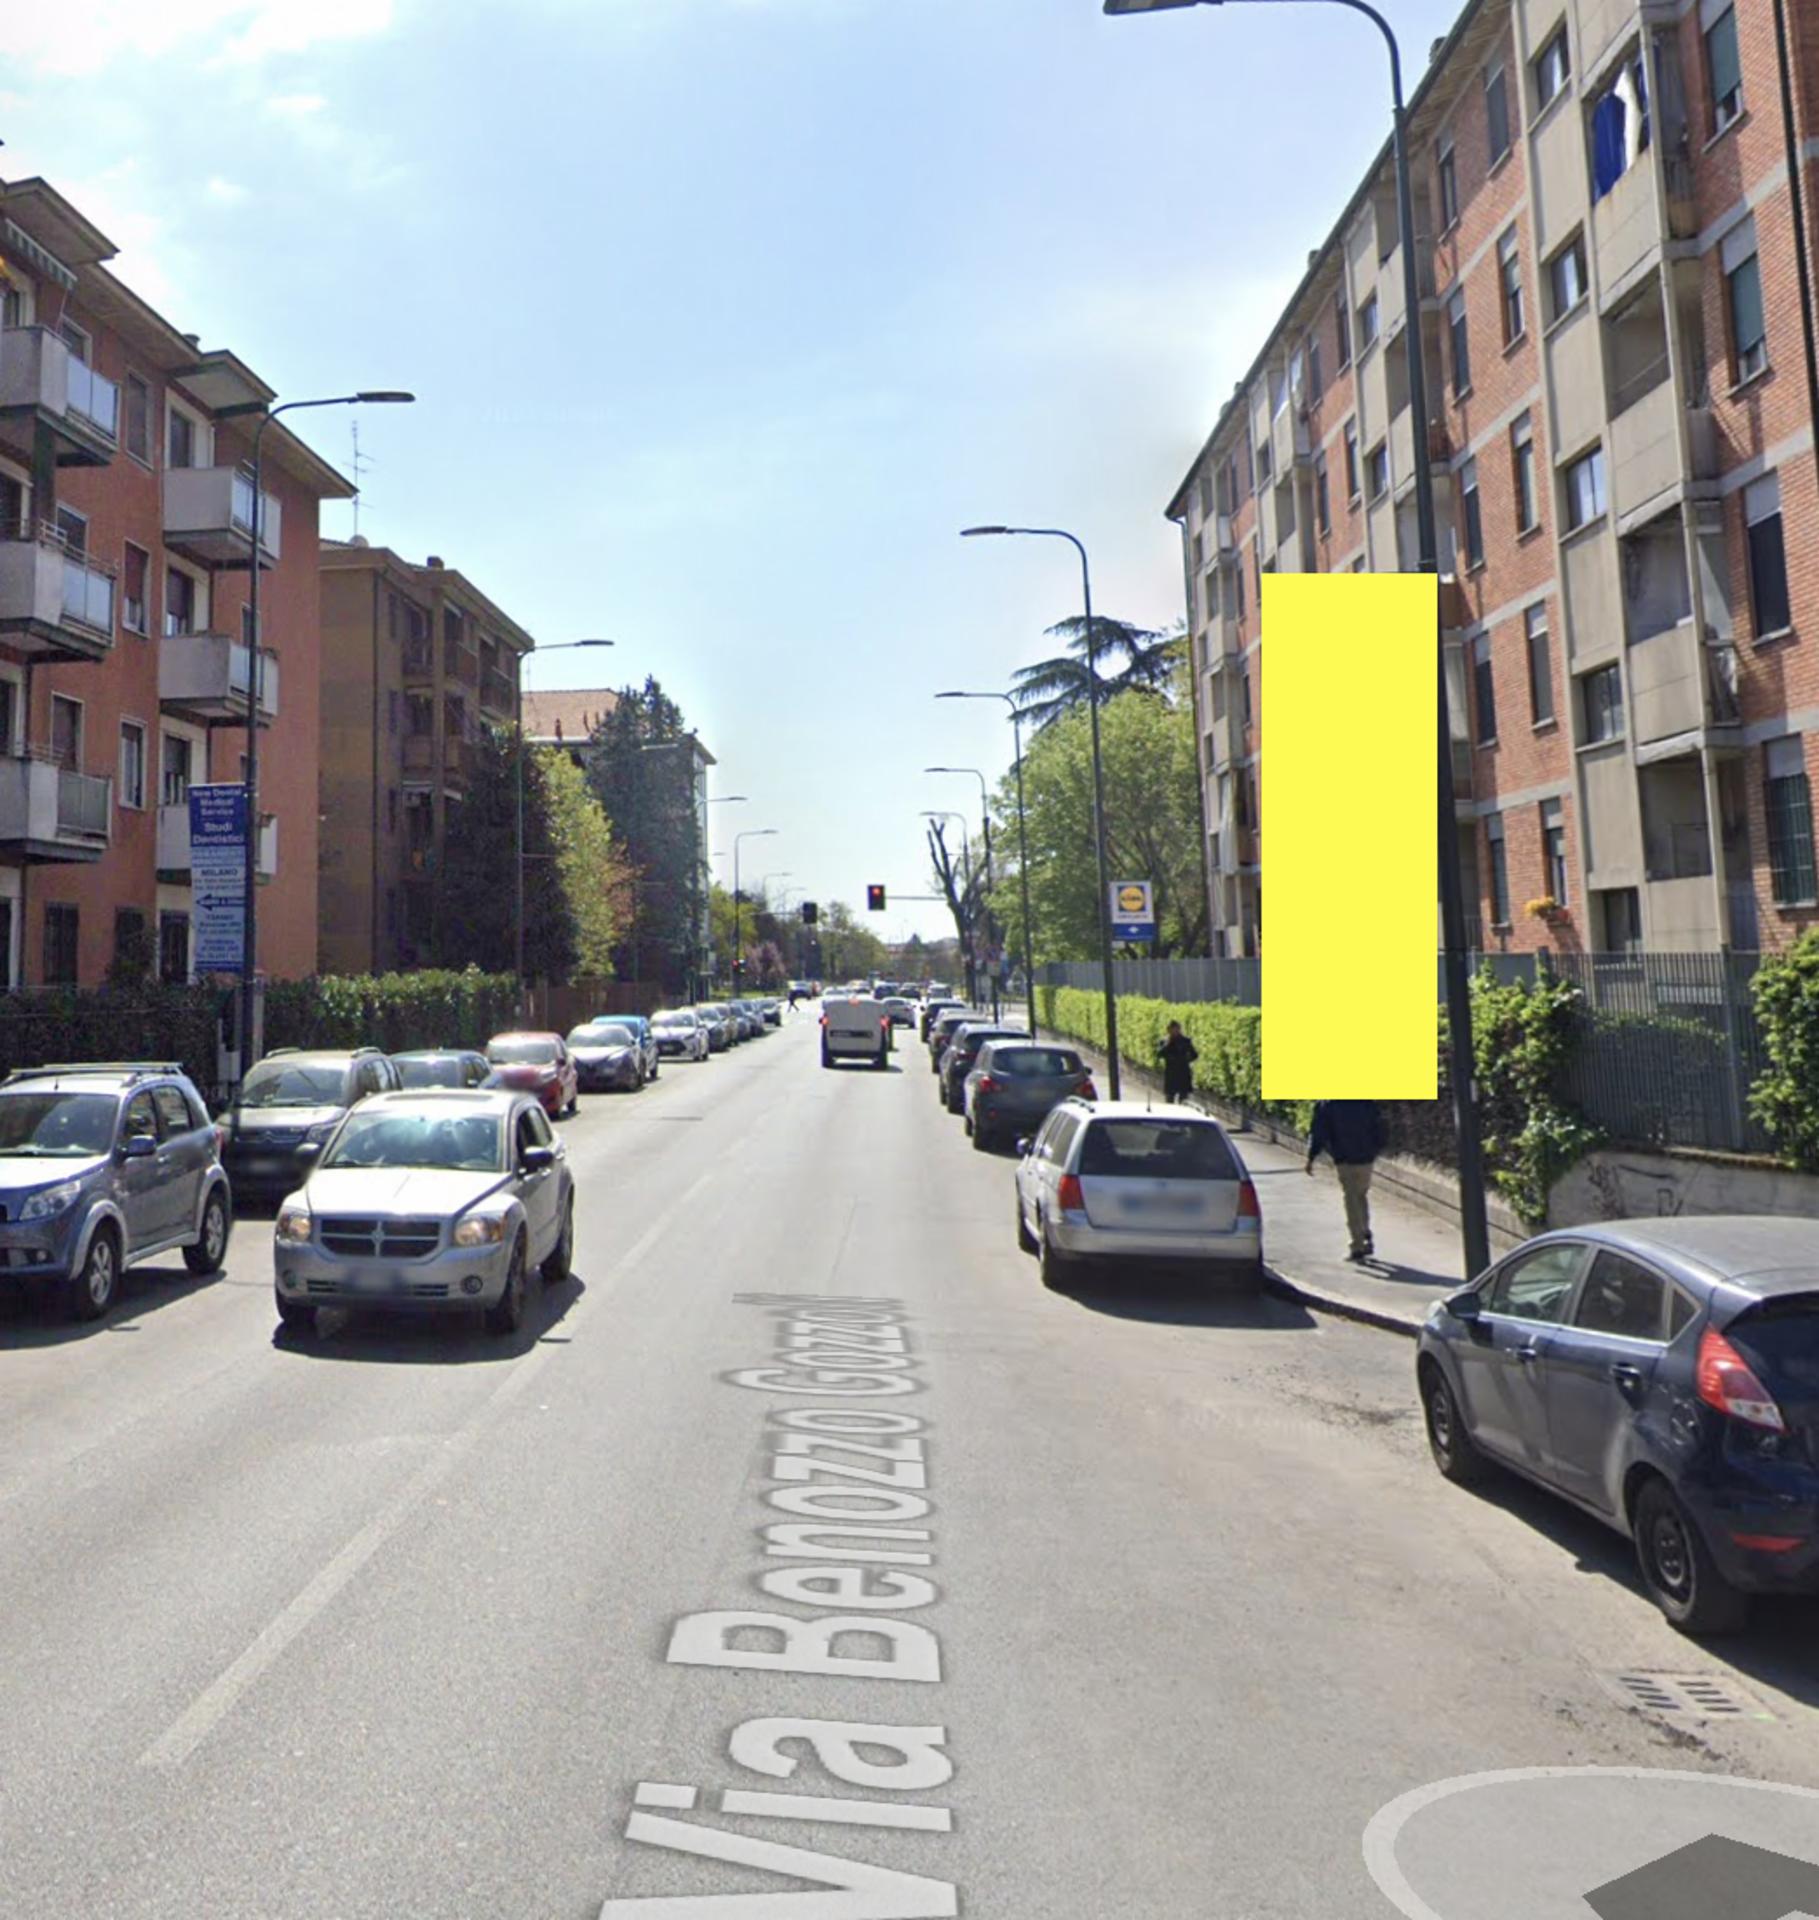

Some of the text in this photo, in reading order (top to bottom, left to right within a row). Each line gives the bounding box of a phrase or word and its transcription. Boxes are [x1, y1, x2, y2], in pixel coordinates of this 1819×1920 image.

[200, 798, 234, 806] Medical
[201, 808, 234, 816] Service
[204, 822, 232, 832] Studi
[201, 868, 238, 876] MILANO
